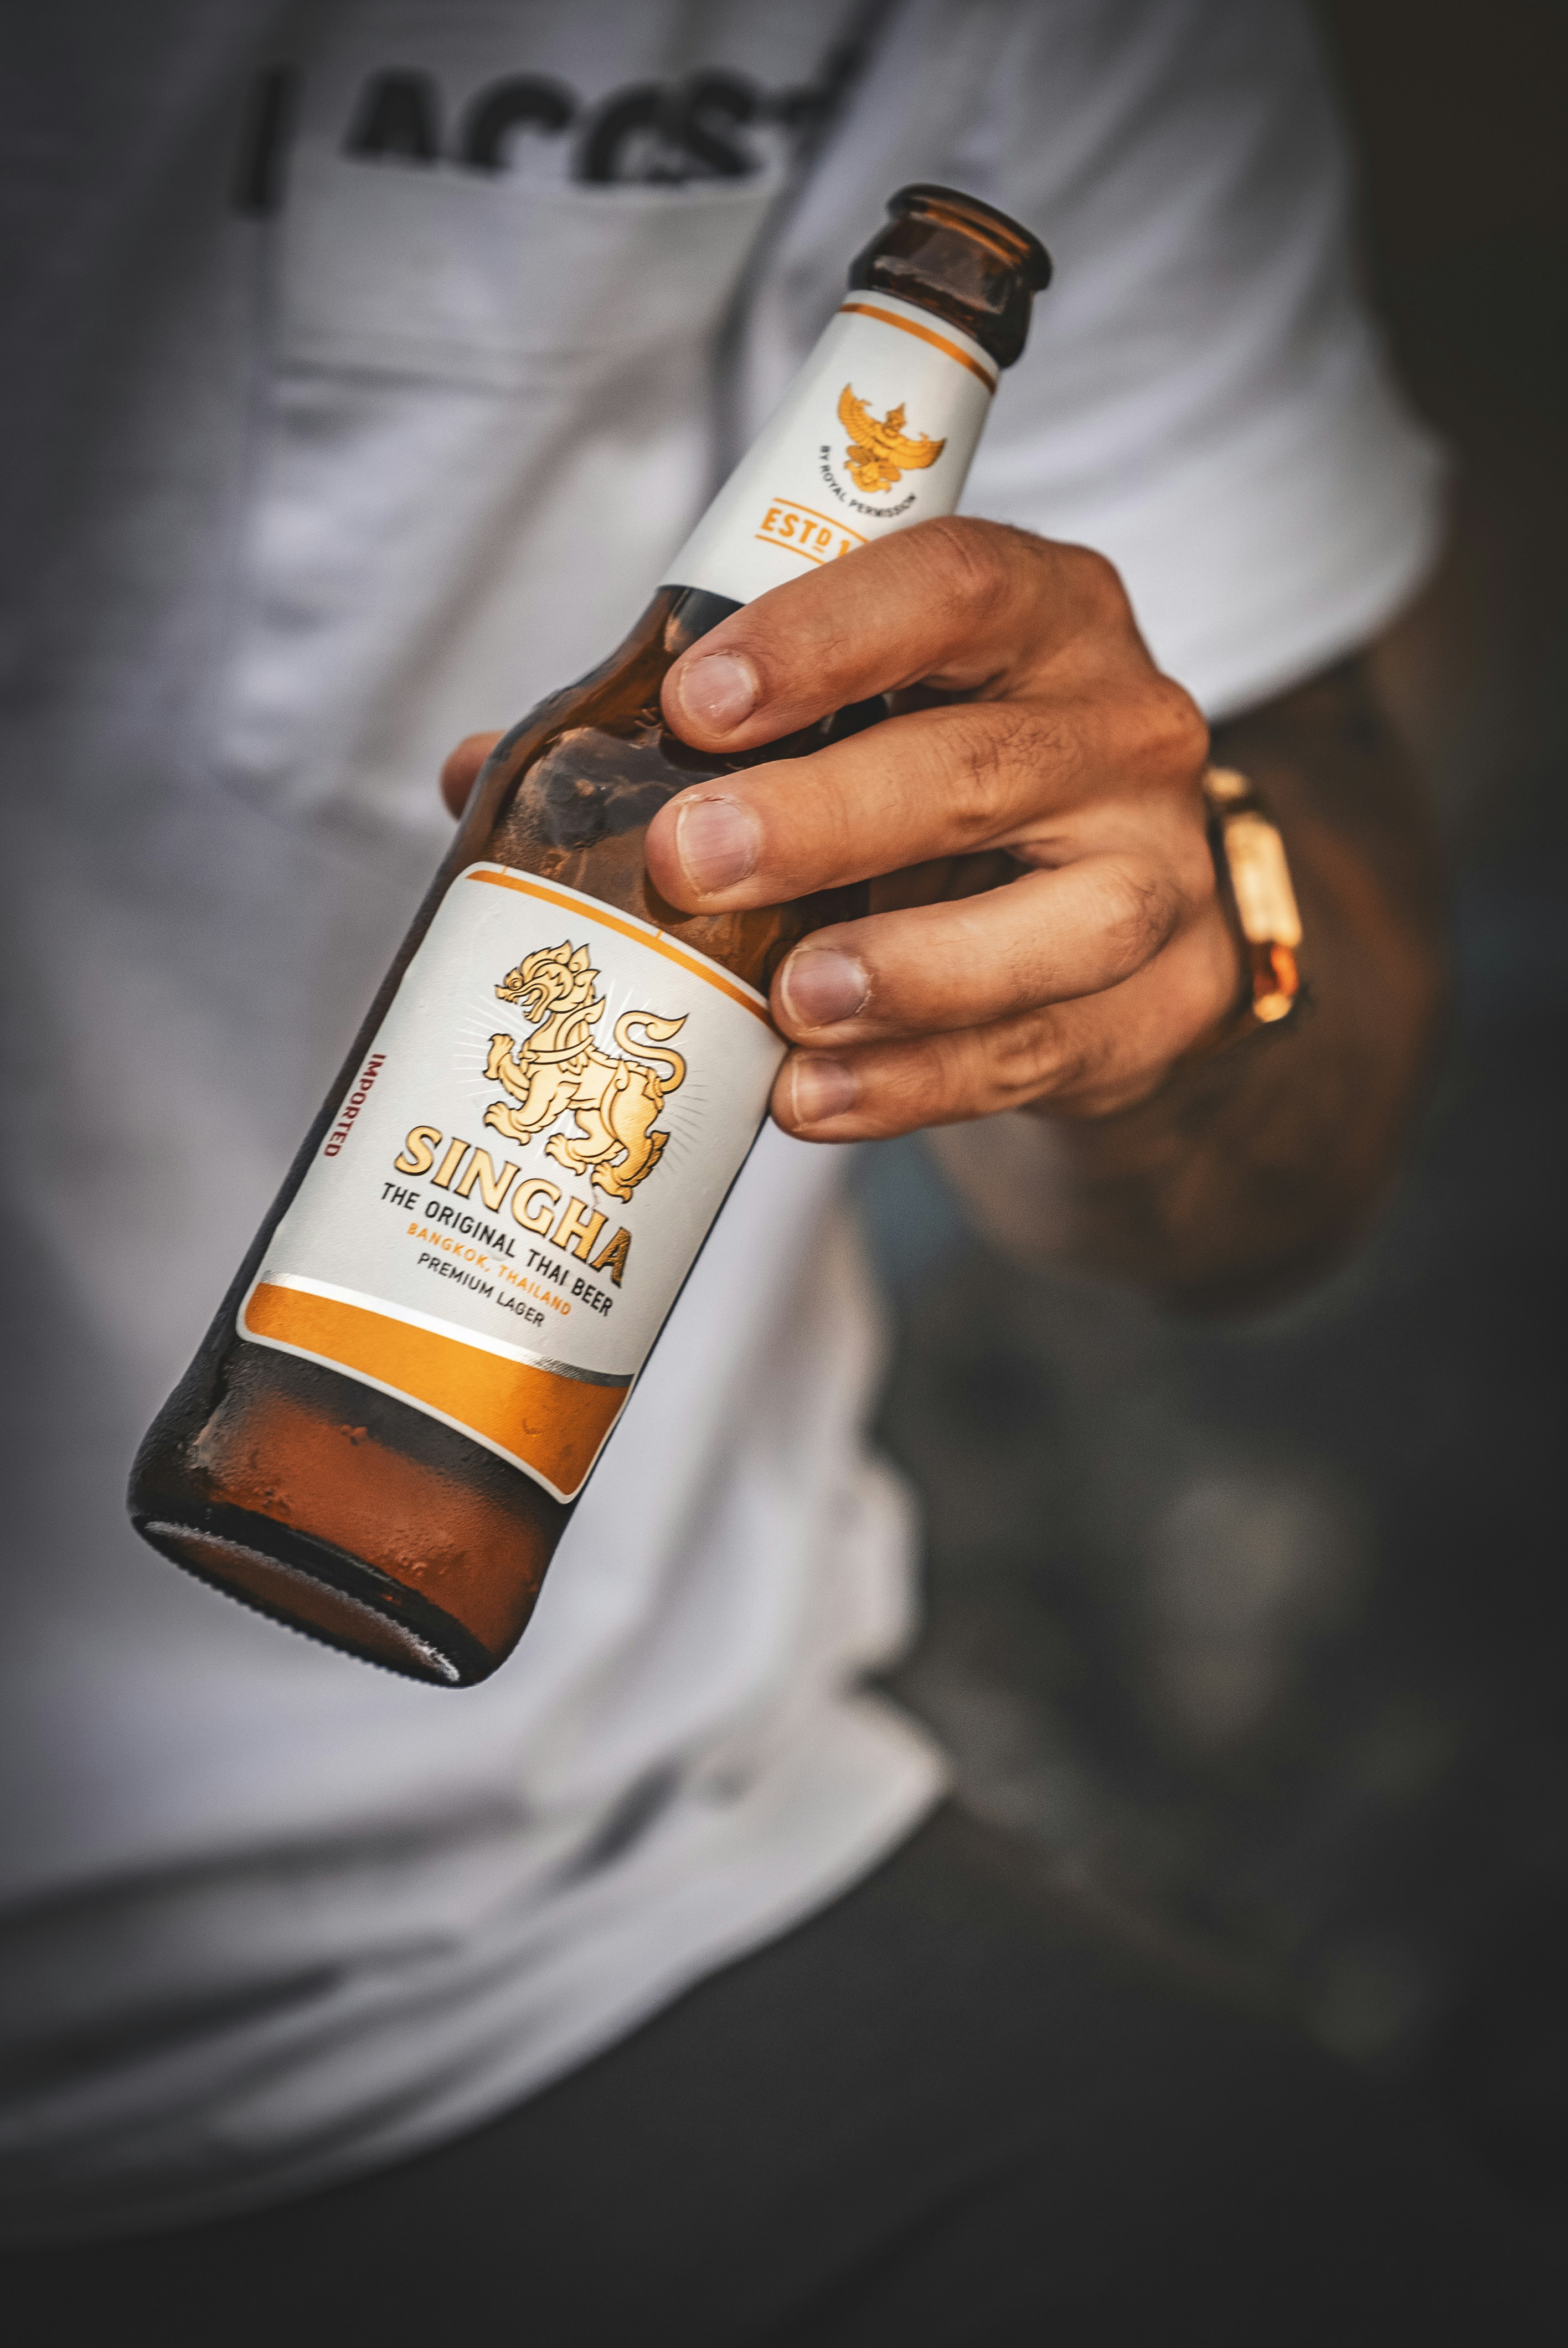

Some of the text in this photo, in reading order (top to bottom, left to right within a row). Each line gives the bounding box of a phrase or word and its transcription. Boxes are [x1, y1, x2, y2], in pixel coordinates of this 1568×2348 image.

[819, 445, 831, 461] BY
[820, 465, 846, 502] ROYAL
[324, 1054, 386, 1157] IMPORTED
[381, 1182, 613, 1317] THE ORIGINAL THAI BEER
[394, 1126, 632, 1288] SINGHA
[407, 1223, 571, 1315] BANGKOK, THAILAND
[417, 1253, 545, 1327] PREMIUM LAGER
